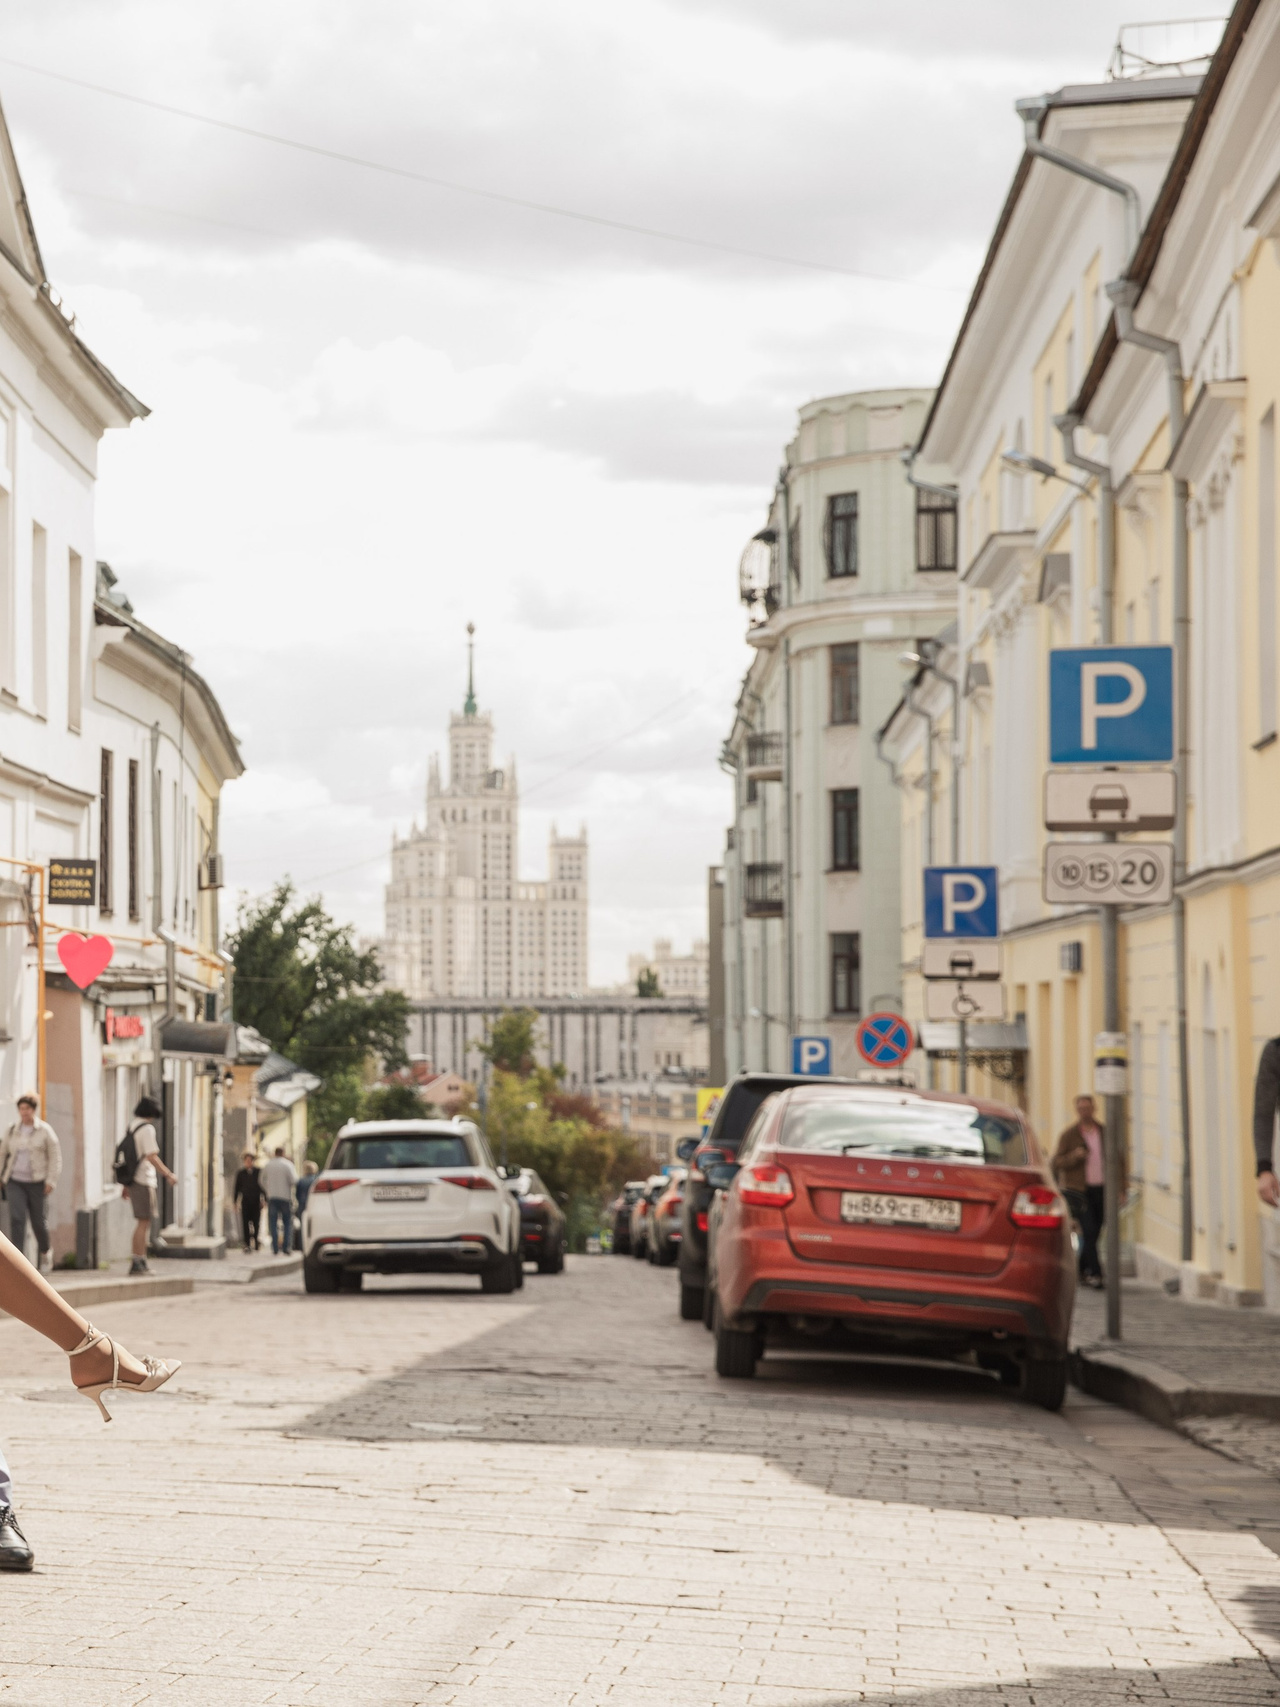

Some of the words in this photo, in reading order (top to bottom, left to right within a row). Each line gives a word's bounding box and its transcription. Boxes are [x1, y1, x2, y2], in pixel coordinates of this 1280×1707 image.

[1080, 661, 1147, 750] P
[1061, 864, 1079, 881] 10
[1088, 862, 1110, 883] 15
[1121, 860, 1157, 885] 20
[942, 873, 987, 933] P
[799, 1040, 827, 1074] P
[856, 1163, 945, 1180] LADA
